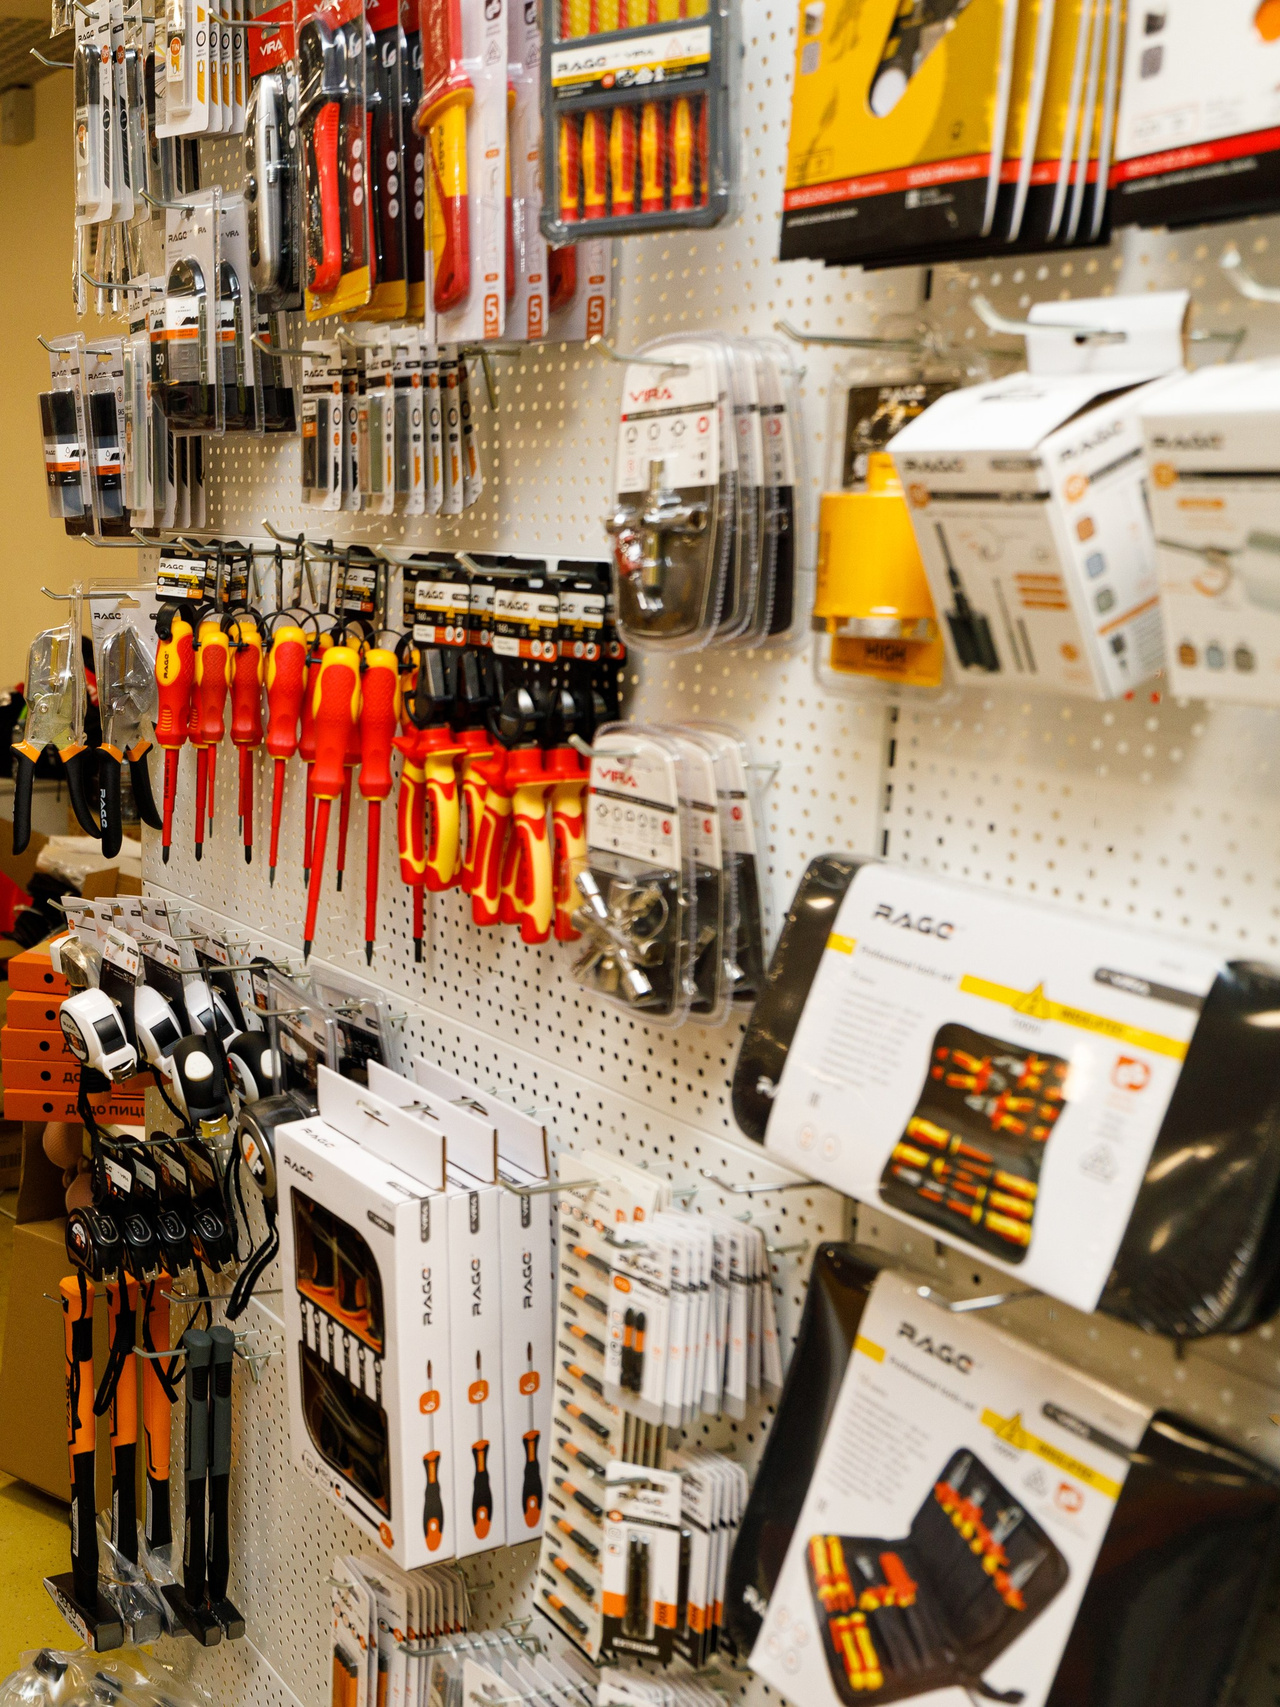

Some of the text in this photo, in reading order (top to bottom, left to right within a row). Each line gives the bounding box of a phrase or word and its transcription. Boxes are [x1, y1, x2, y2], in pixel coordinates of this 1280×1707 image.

[259, 39, 283, 56] VIRA
[529, 298, 541, 323] 5
[589, 299, 602, 324] 5
[155, 353, 165, 366] 50
[629, 387, 674, 405] VIRA
[596, 767, 638, 788] VIRA
